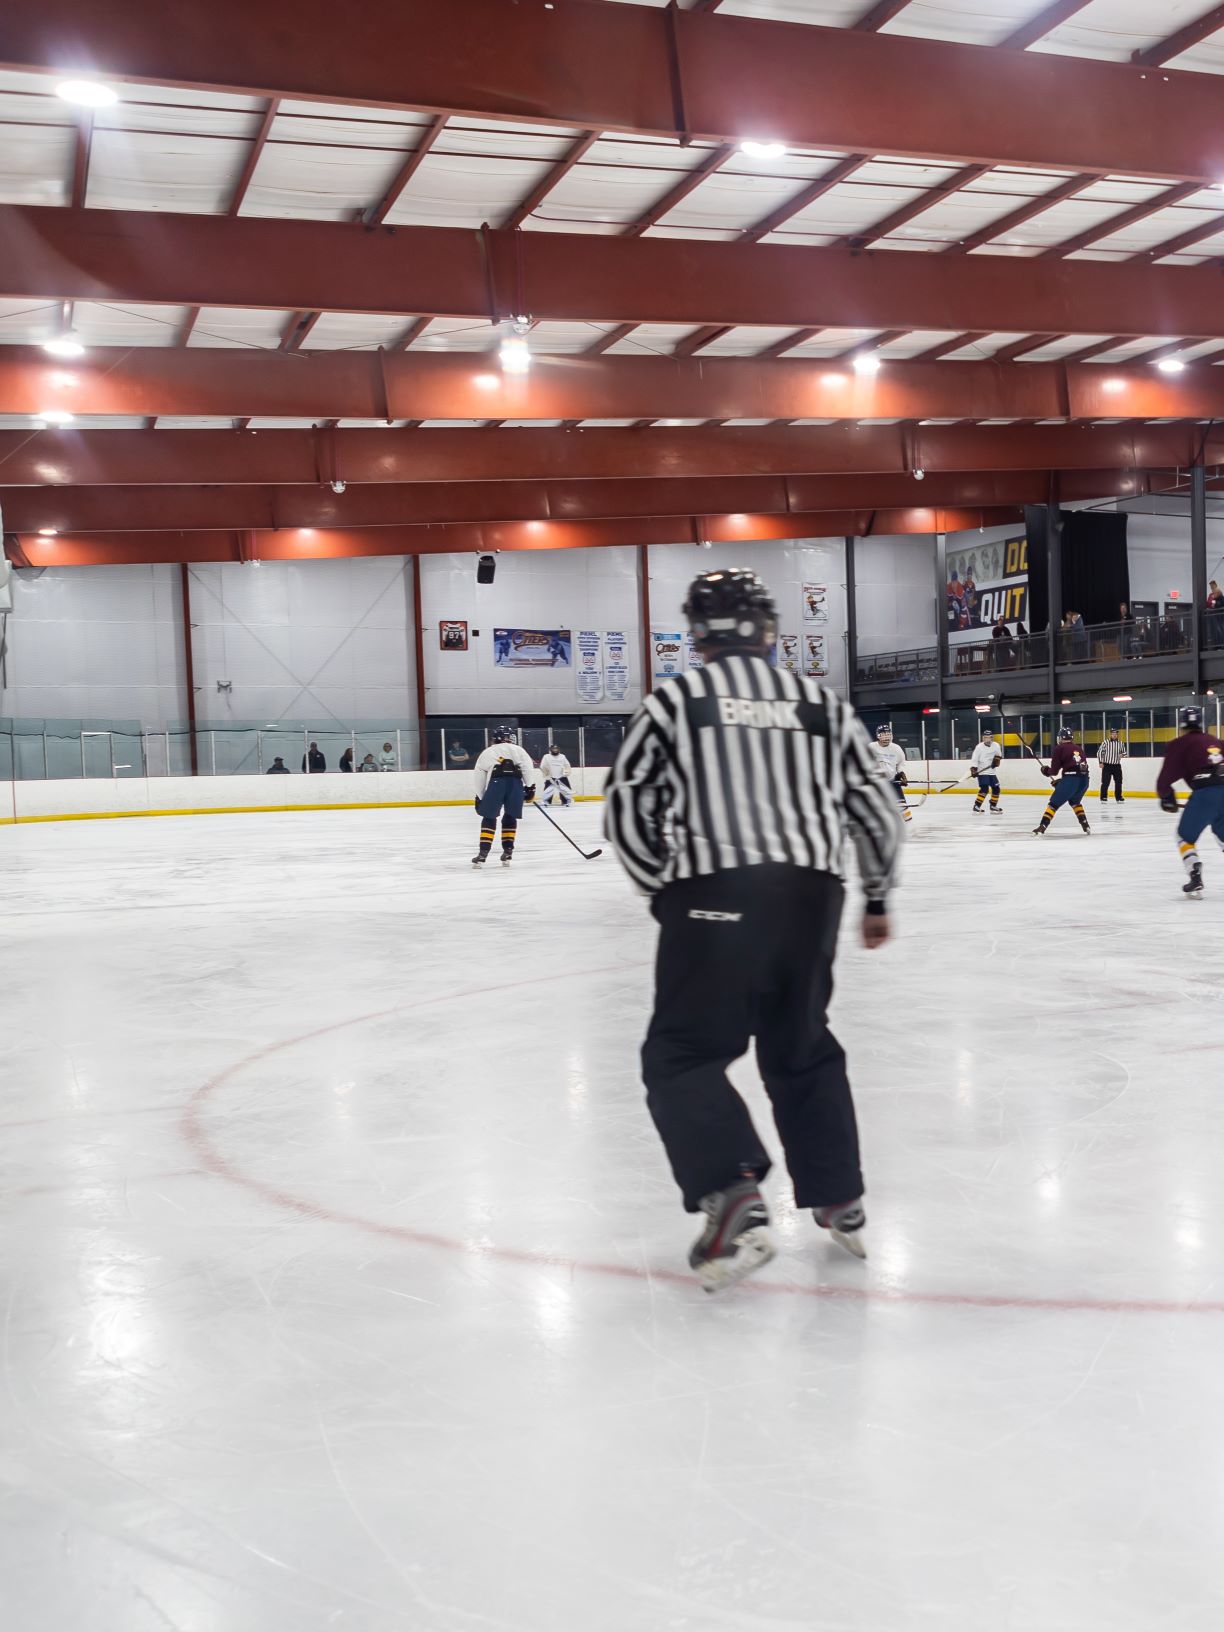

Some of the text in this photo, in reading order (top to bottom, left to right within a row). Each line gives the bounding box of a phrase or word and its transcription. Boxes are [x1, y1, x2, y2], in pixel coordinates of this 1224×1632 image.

[981, 587, 1025, 624] QUIT
[448, 631, 460, 640] 97
[718, 696, 804, 731] BRINK
